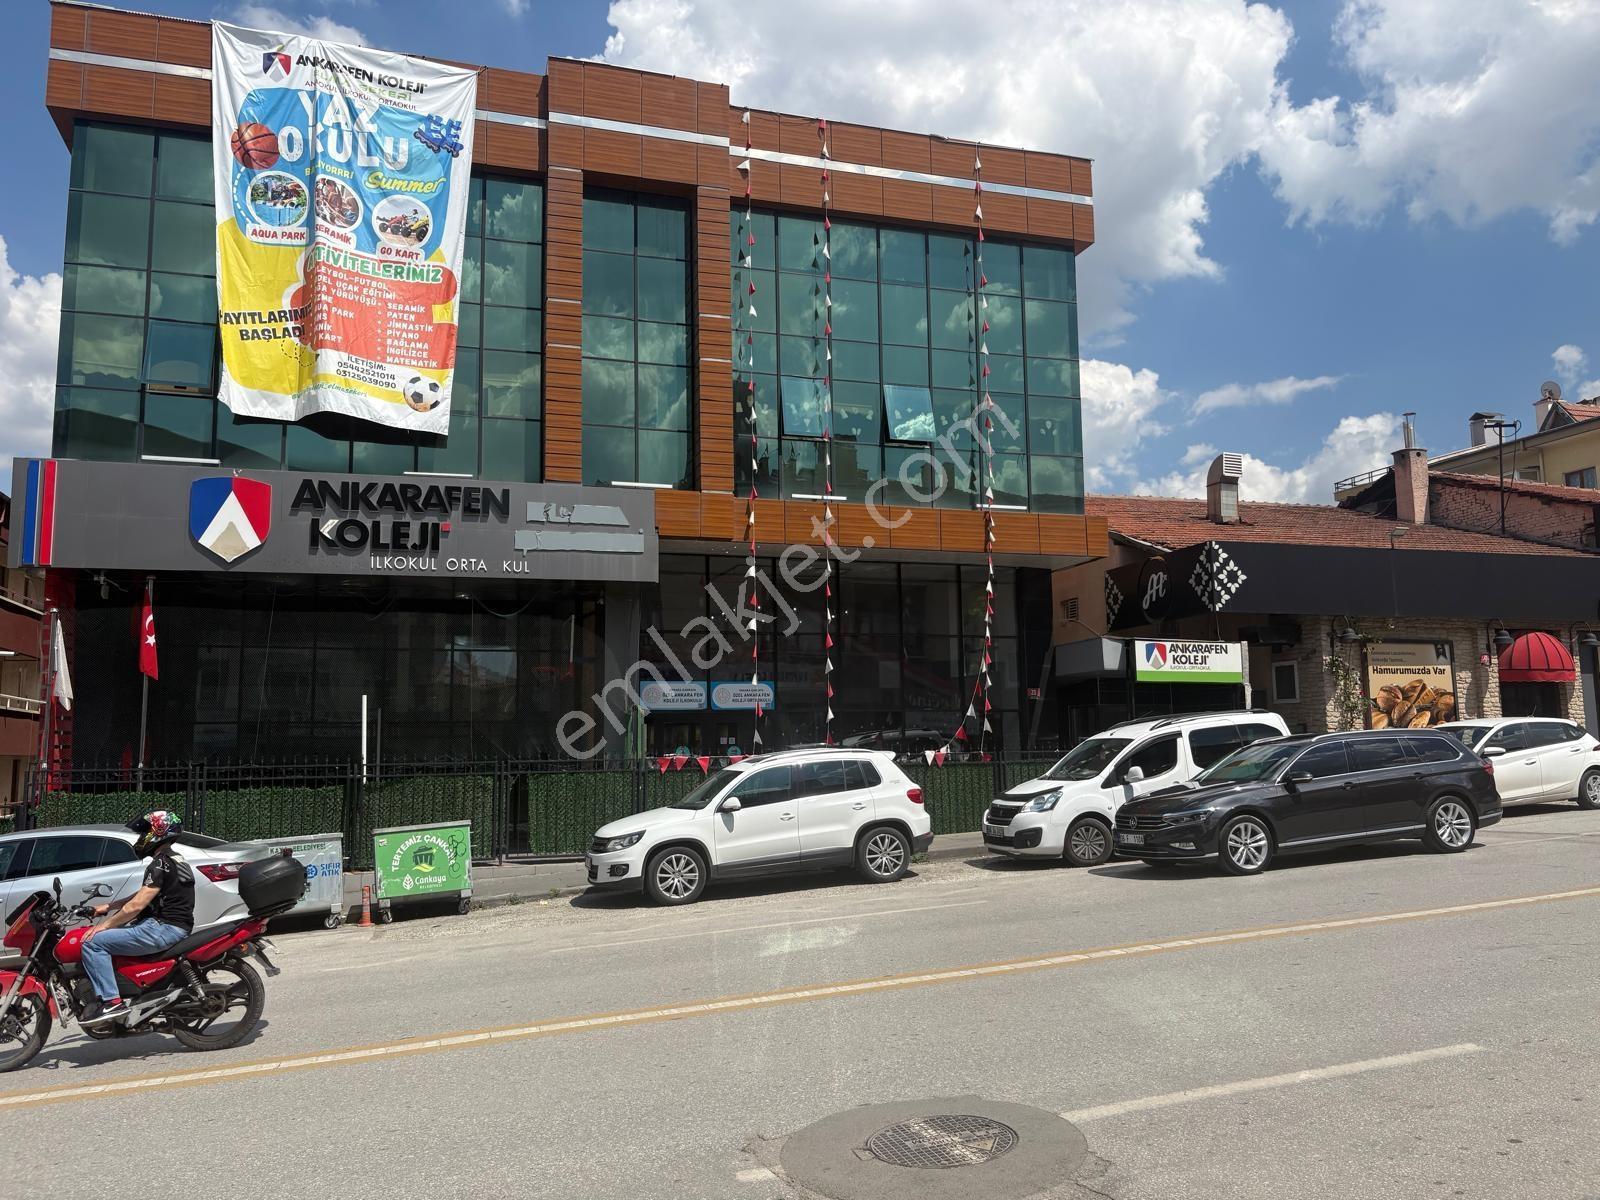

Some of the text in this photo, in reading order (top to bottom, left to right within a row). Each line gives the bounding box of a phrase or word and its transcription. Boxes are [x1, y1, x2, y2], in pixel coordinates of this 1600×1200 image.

[298, 91, 379, 134] YAZ
[278, 122, 409, 171] OKULU
[365, 171, 446, 193] Summer
[251, 228, 306, 240] AQUA PARK
[314, 223, 352, 245] SERAMİK
[380, 246, 421, 260] GO KART
[307, 245, 443, 283] ATİVİTELERİMİZ
[336, 281, 359, 292] UÇAK
[331, 307, 355, 318] PARK
[386, 302, 426, 313] SERAMİK
[386, 312, 415, 321] PATEN
[318, 333, 343, 342] KART
[386, 329, 420, 339] PİYANO
[386, 338, 429, 350] BAĞLAMA
[386, 345, 429, 358] İNGİLİZCE
[386, 356, 438, 368] MATEMATİK
[290, 478, 511, 519] ANKARAFEN
[371, 552, 438, 570] İLKOKUL
[1169, 643, 1228, 654] ANKARAFEN
[1372, 666, 1447, 675] Hamurumuzda Var
[391, 834, 422, 872] TERTEMİZ
[320, 862, 341, 871] SIFIR
[321, 869, 340, 877] ATIK
